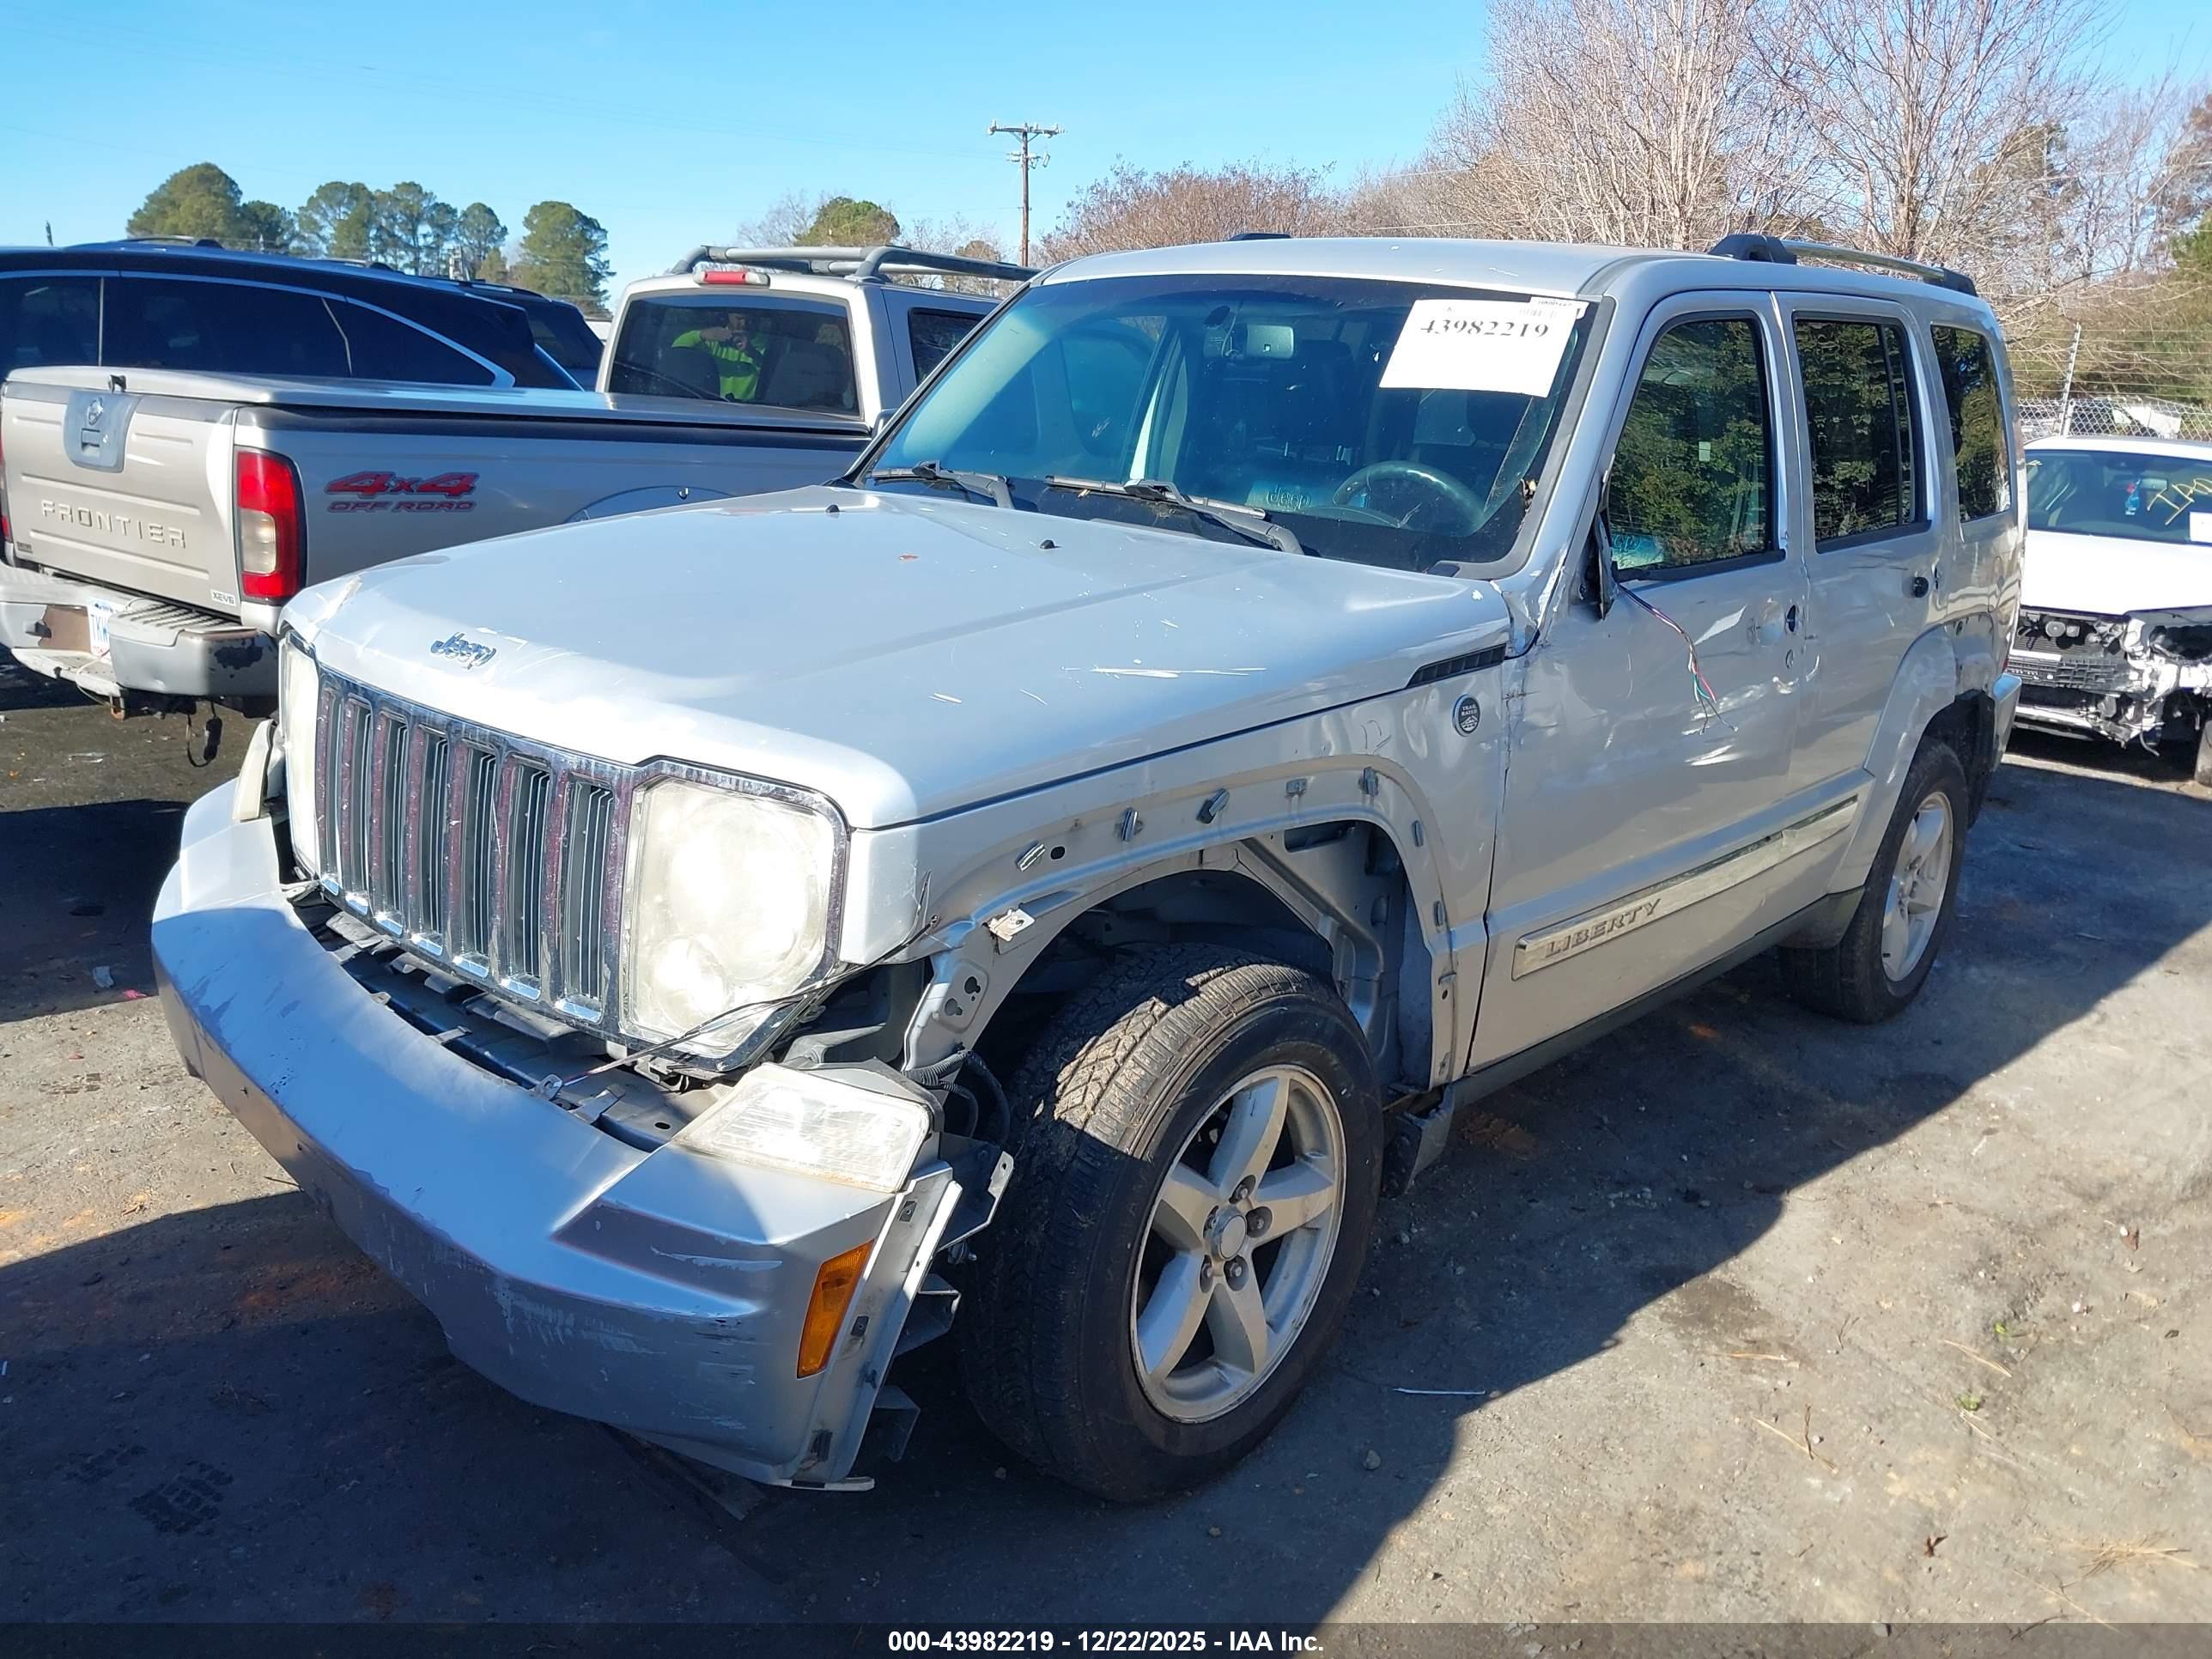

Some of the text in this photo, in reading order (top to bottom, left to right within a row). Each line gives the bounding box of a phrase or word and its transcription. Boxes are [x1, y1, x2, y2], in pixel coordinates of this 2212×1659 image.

[1420, 319, 1549, 337] 43982219
[324, 471, 480, 499] 4x4
[328, 501, 477, 513] OFF ROAD
[42, 500, 185, 549] FRONTIER
[430, 631, 497, 670] Jeep
[1547, 898, 1662, 955] LIBERTY
